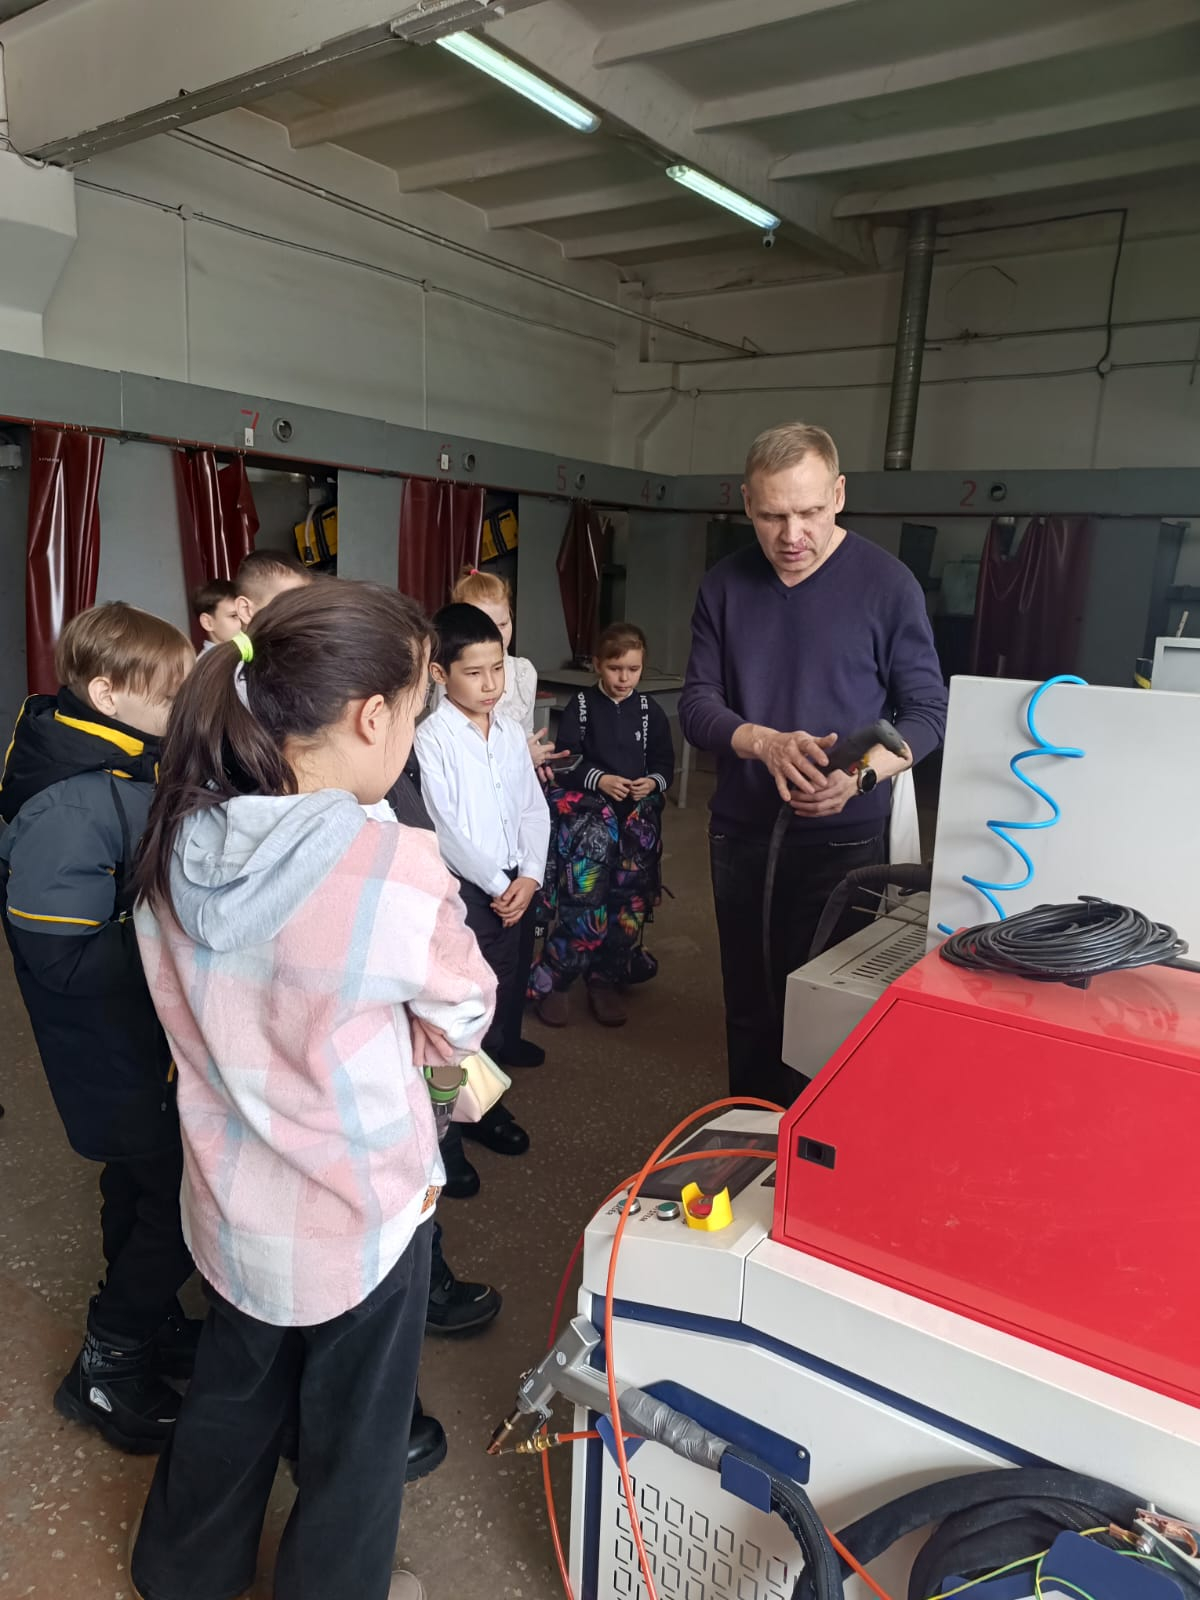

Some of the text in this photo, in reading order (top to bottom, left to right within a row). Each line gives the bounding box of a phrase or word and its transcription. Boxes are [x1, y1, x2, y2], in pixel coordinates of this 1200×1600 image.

[240, 408, 260, 431] 7
[556, 464, 567, 491] 5
[640, 479, 650, 504] 4
[719, 481, 732, 506] 3
[959, 480, 977, 508] 2
[639, 694, 649, 710] ICE
